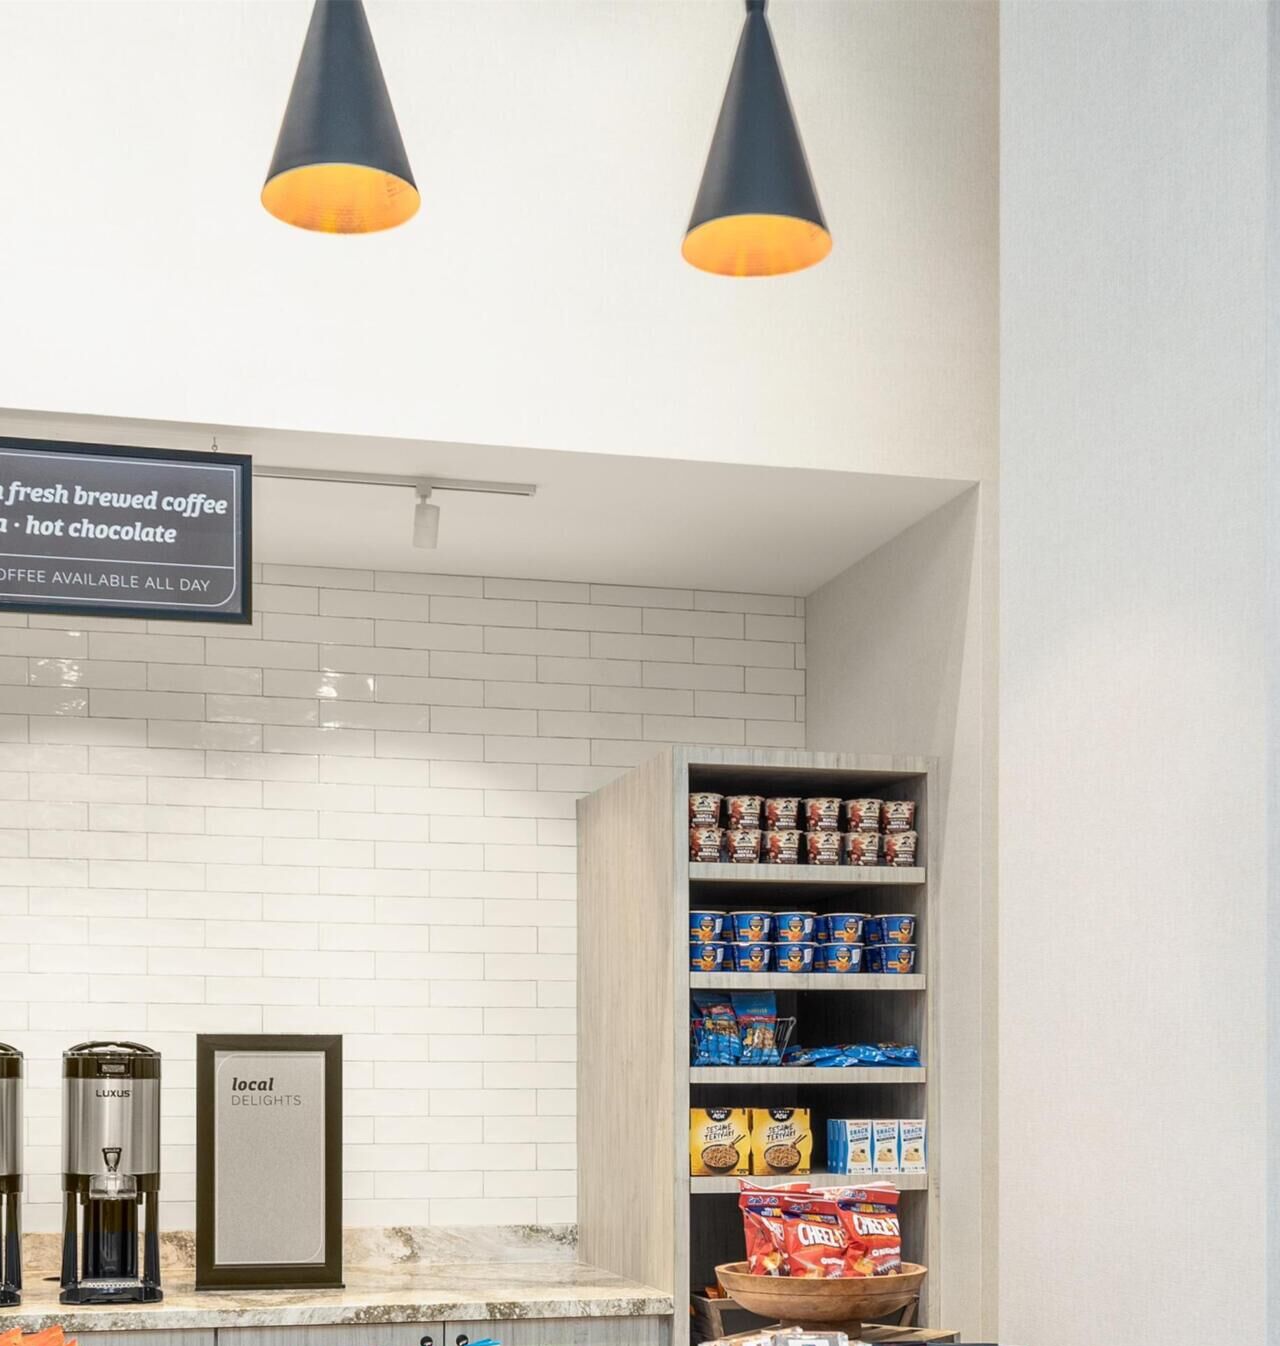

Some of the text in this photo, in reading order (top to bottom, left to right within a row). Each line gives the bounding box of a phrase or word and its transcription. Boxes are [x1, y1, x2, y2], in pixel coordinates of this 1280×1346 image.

[5, 482, 69, 506] fresh
[74, 485, 158, 512] brewed
[161, 493, 228, 517] coffee
[25, 515, 65, 537] hot
[68, 518, 177, 543] chocolate
[52, 571, 139, 590] AVAILABLE
[144, 576, 175, 591] ALL
[180, 578, 210, 592] DAY
[232, 1077, 274, 1091] local
[95, 1089, 131, 1098] LUXUS
[231, 1095, 302, 1106] DELIGHTS
